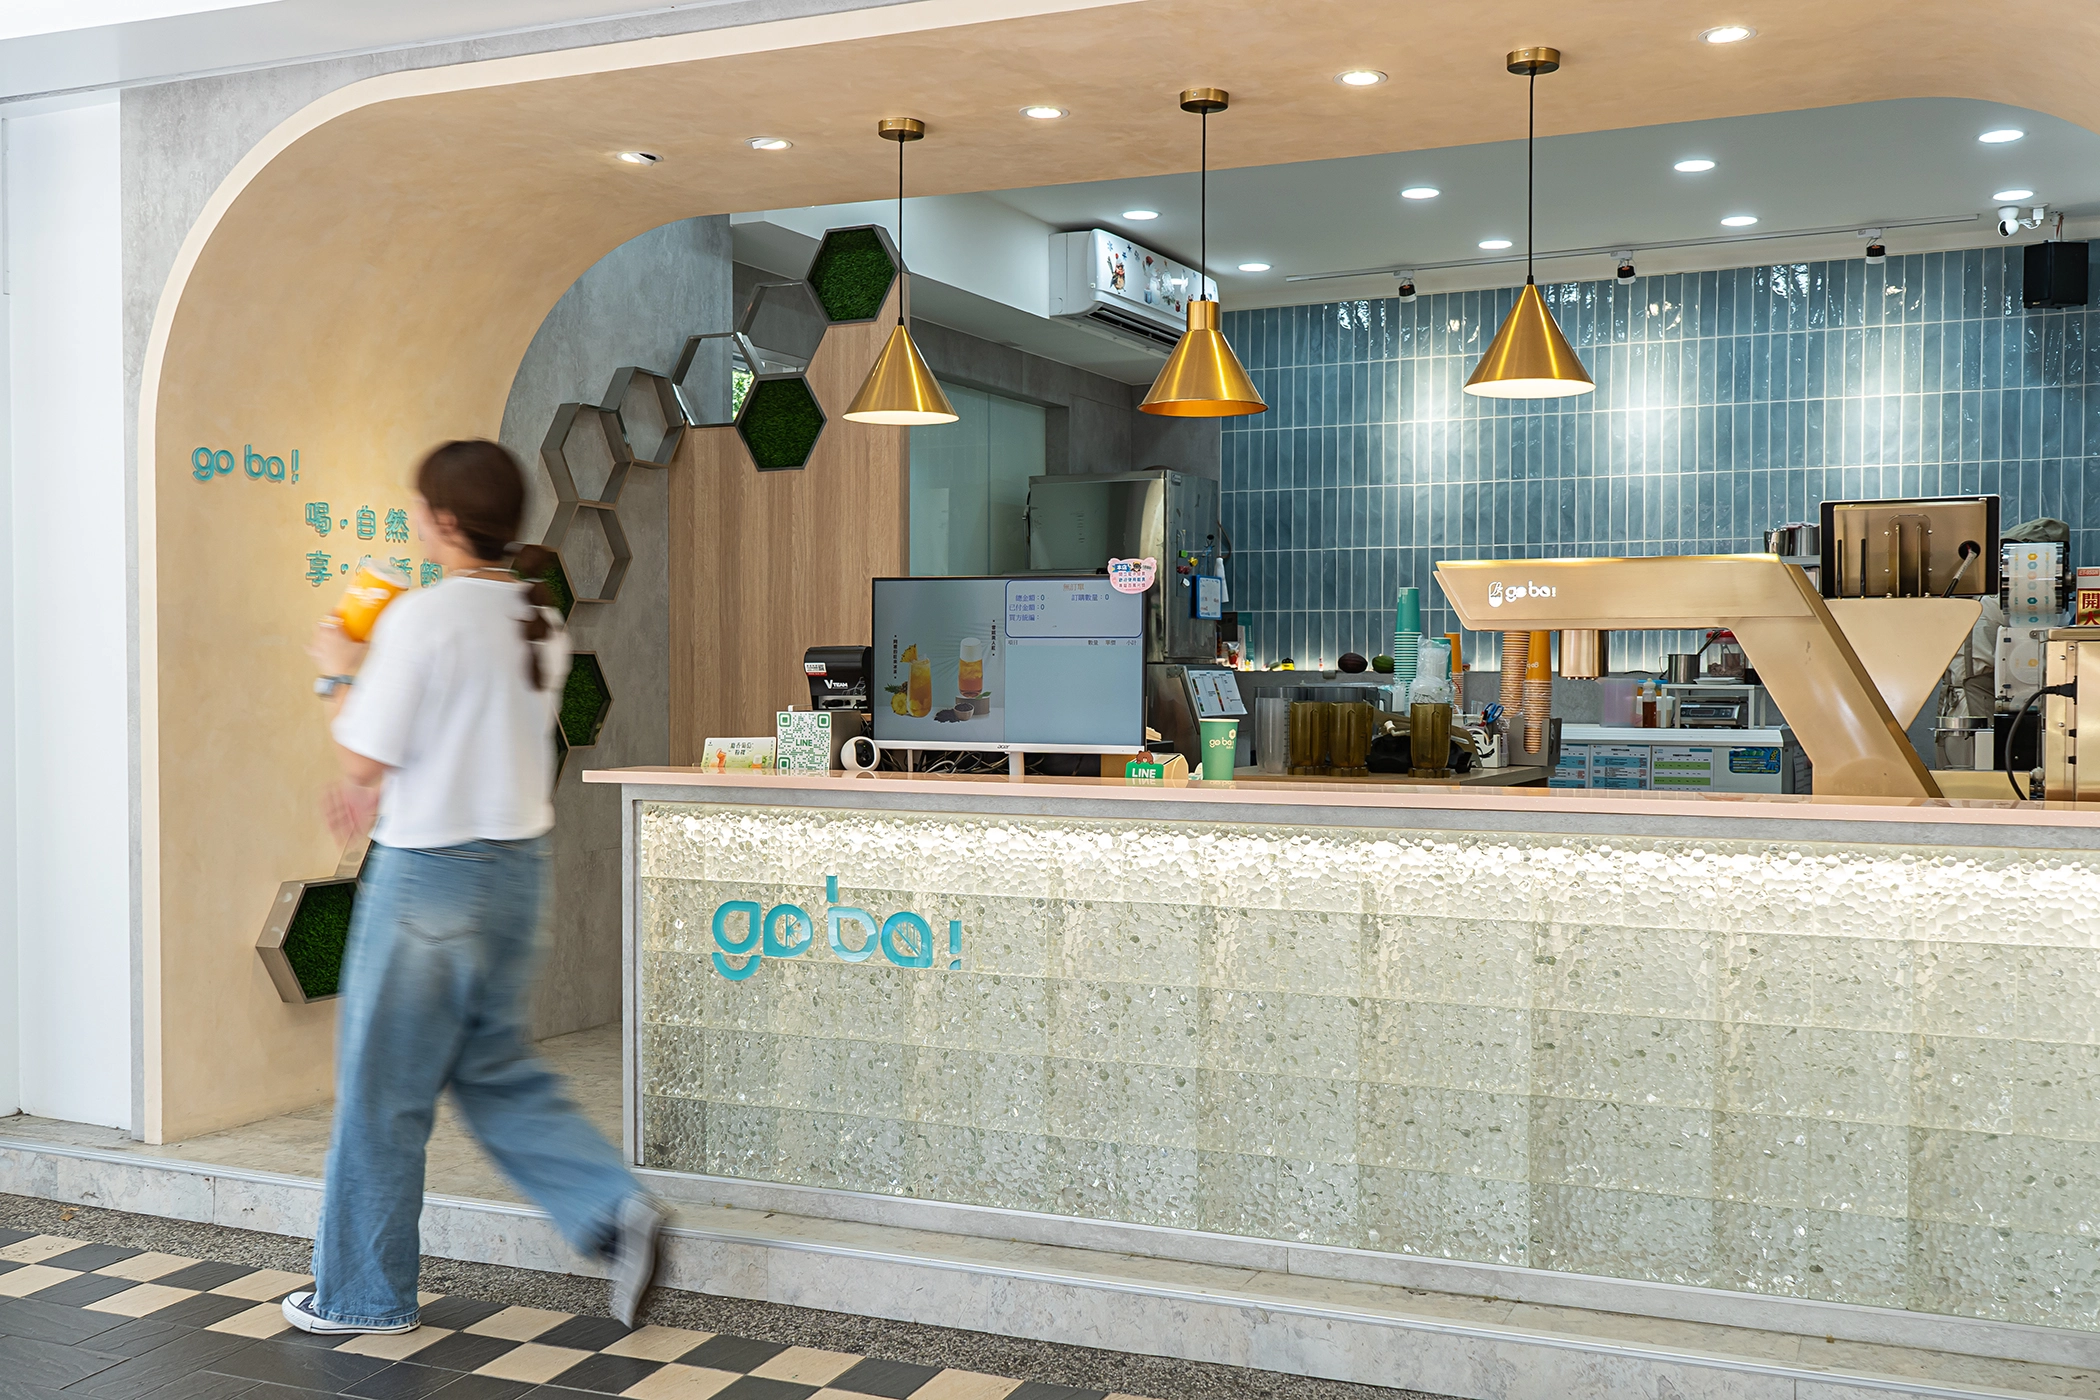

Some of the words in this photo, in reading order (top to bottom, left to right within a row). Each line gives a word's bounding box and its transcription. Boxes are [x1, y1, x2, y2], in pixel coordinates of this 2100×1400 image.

[191, 446, 235, 482] go
[1505, 586, 1527, 603] go
[795, 739, 813, 747] LINE
[1208, 739, 1221, 748] go
[1132, 768, 1156, 779] LINE
[712, 900, 814, 982] go
